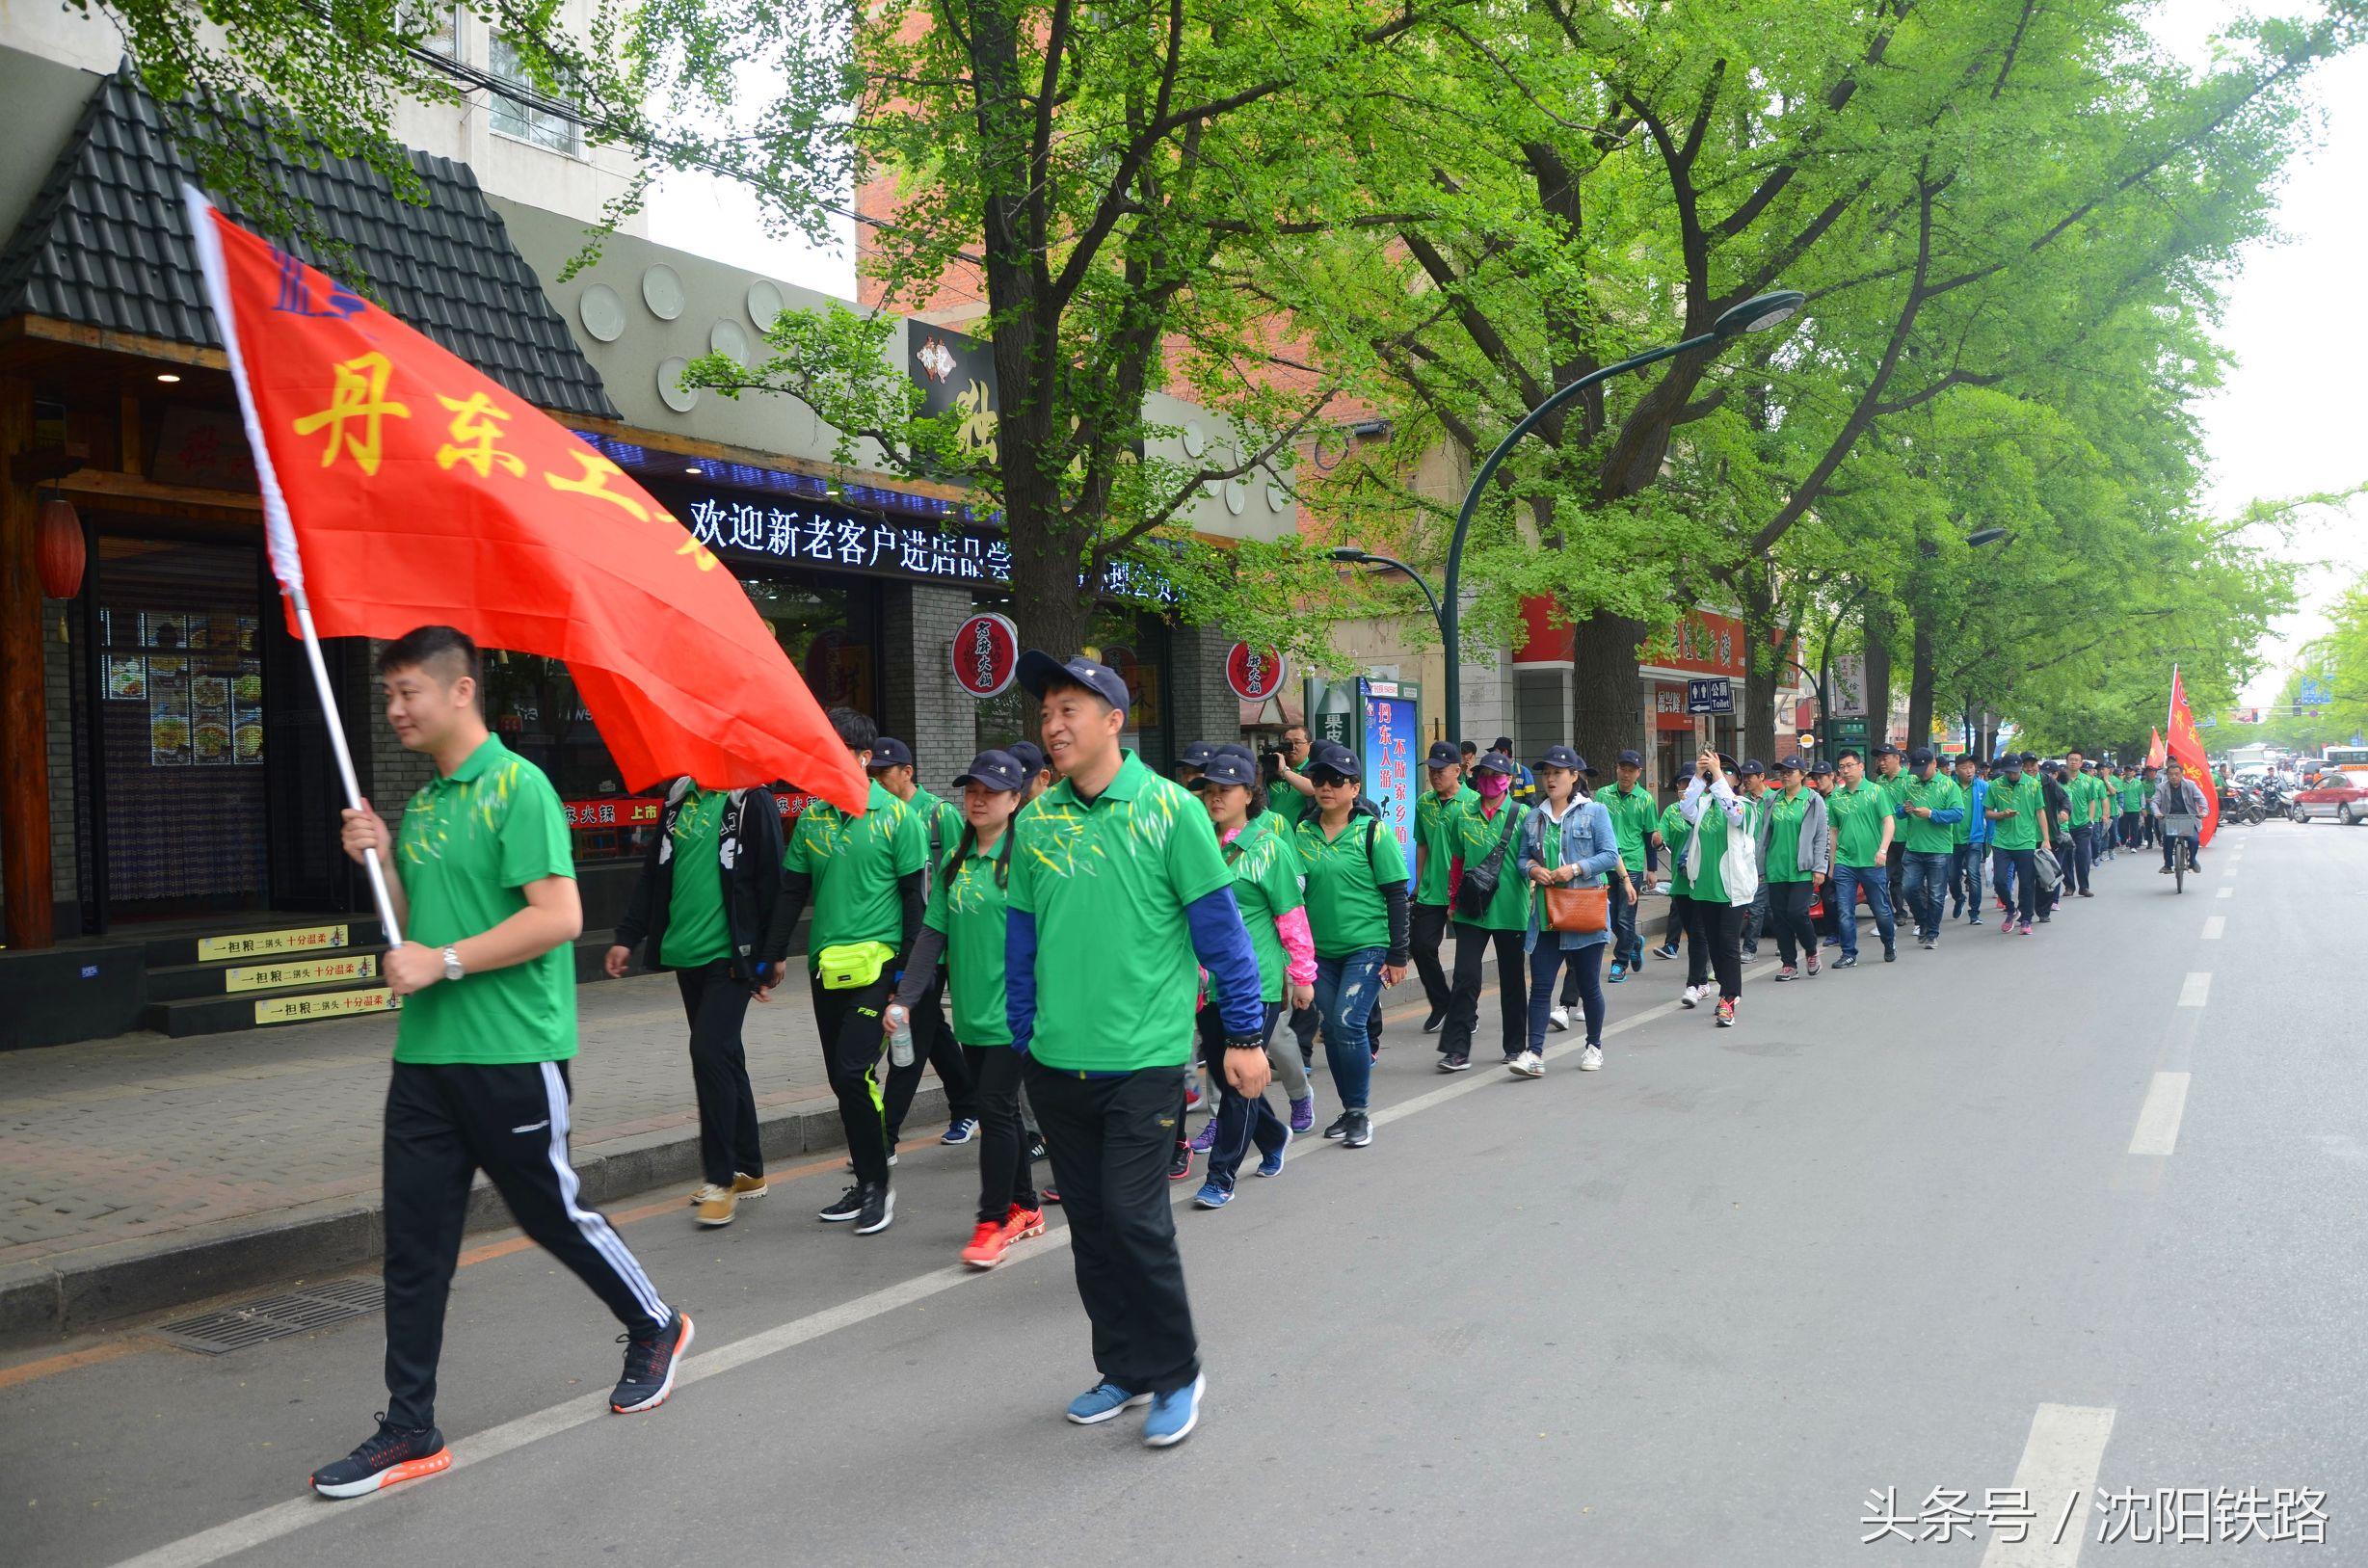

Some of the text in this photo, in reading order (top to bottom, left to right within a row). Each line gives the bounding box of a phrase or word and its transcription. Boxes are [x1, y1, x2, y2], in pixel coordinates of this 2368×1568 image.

[974, 621, 994, 688] 老麻火锅
[1710, 681, 1728, 698] 公厕
[1712, 699, 1730, 709] Toilet
[1324, 714, 1344, 744] 果皮
[1378, 703, 1393, 788] 丹东人游
[631, 805, 657, 820] 上市
[286, 933, 328, 946] 十分温柔
[314, 963, 355, 976] 十分温柔
[343, 994, 384, 1008] 十分温柔
